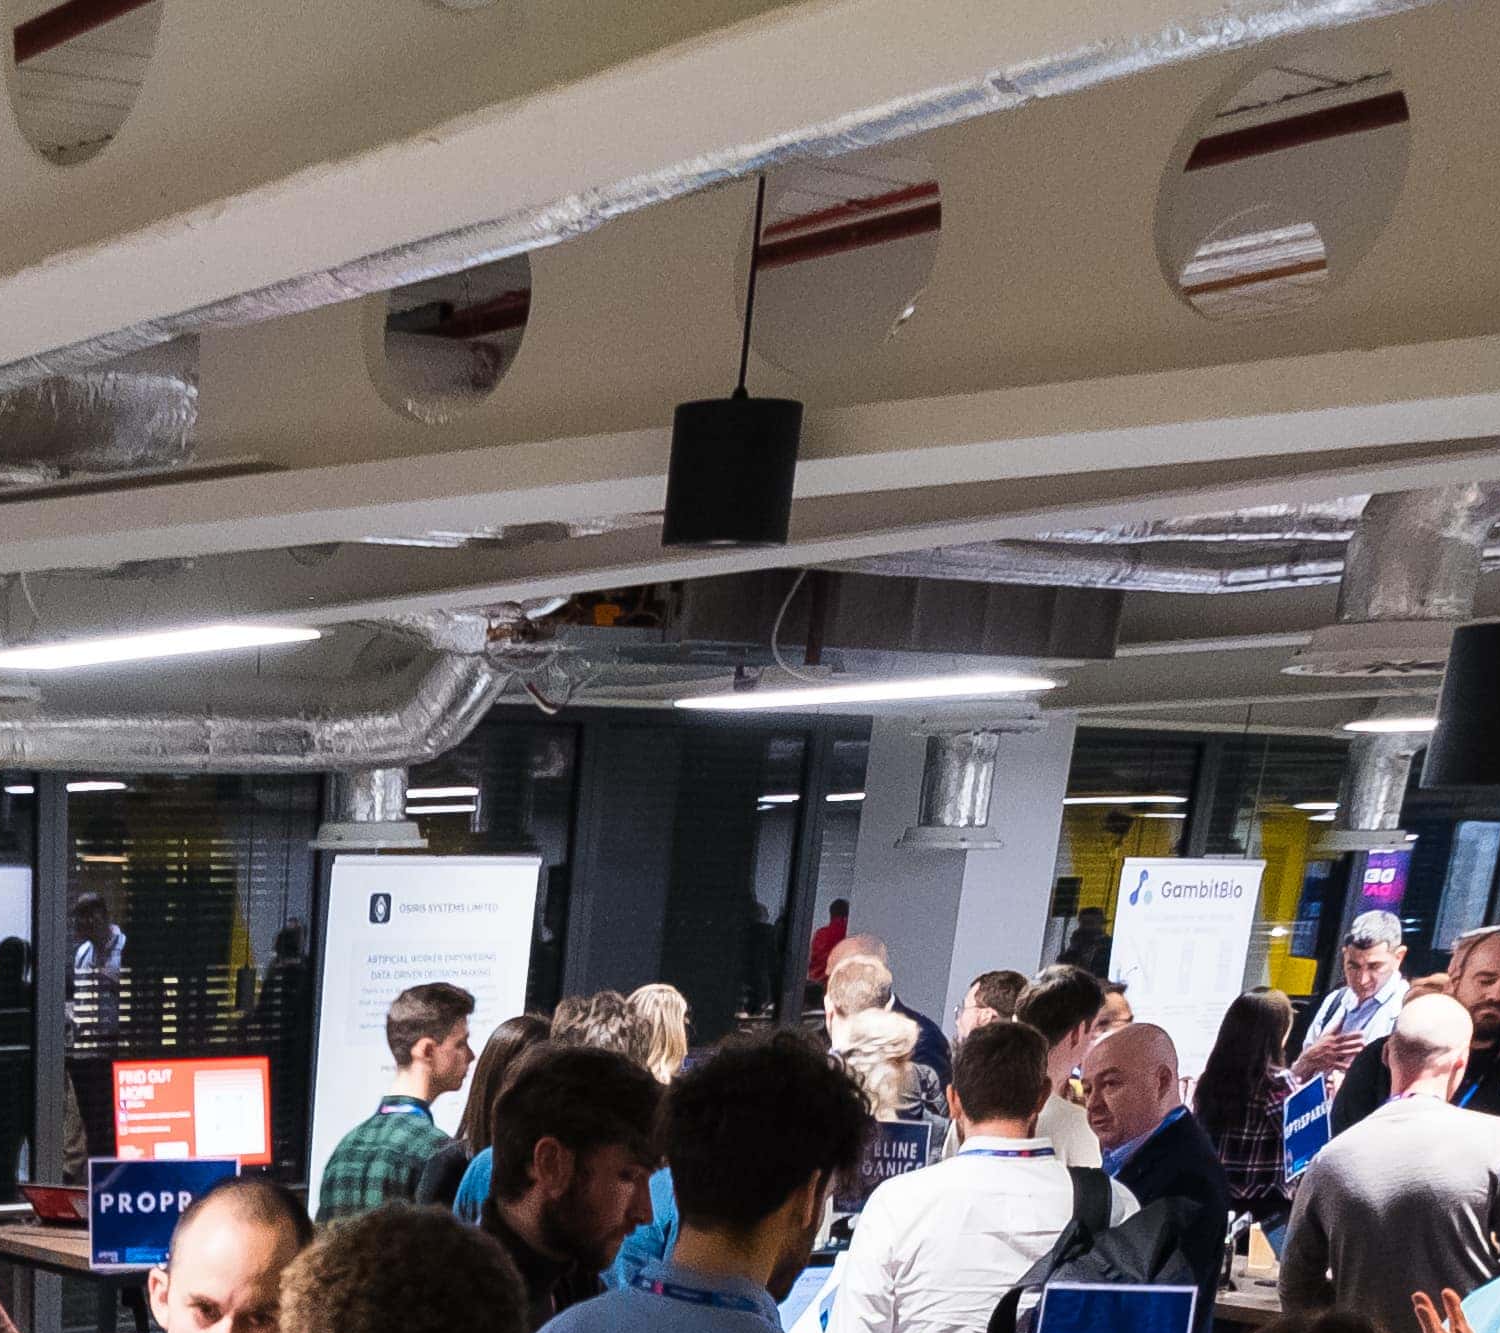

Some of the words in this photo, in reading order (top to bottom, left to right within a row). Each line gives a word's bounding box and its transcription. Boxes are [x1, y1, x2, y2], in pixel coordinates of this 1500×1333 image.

[1161, 879, 1243, 899] GambitBio
[428, 903, 465, 913] SYSTEMS
[467, 903, 498, 913] LIMITED
[873, 1141, 918, 1160] ELINE
